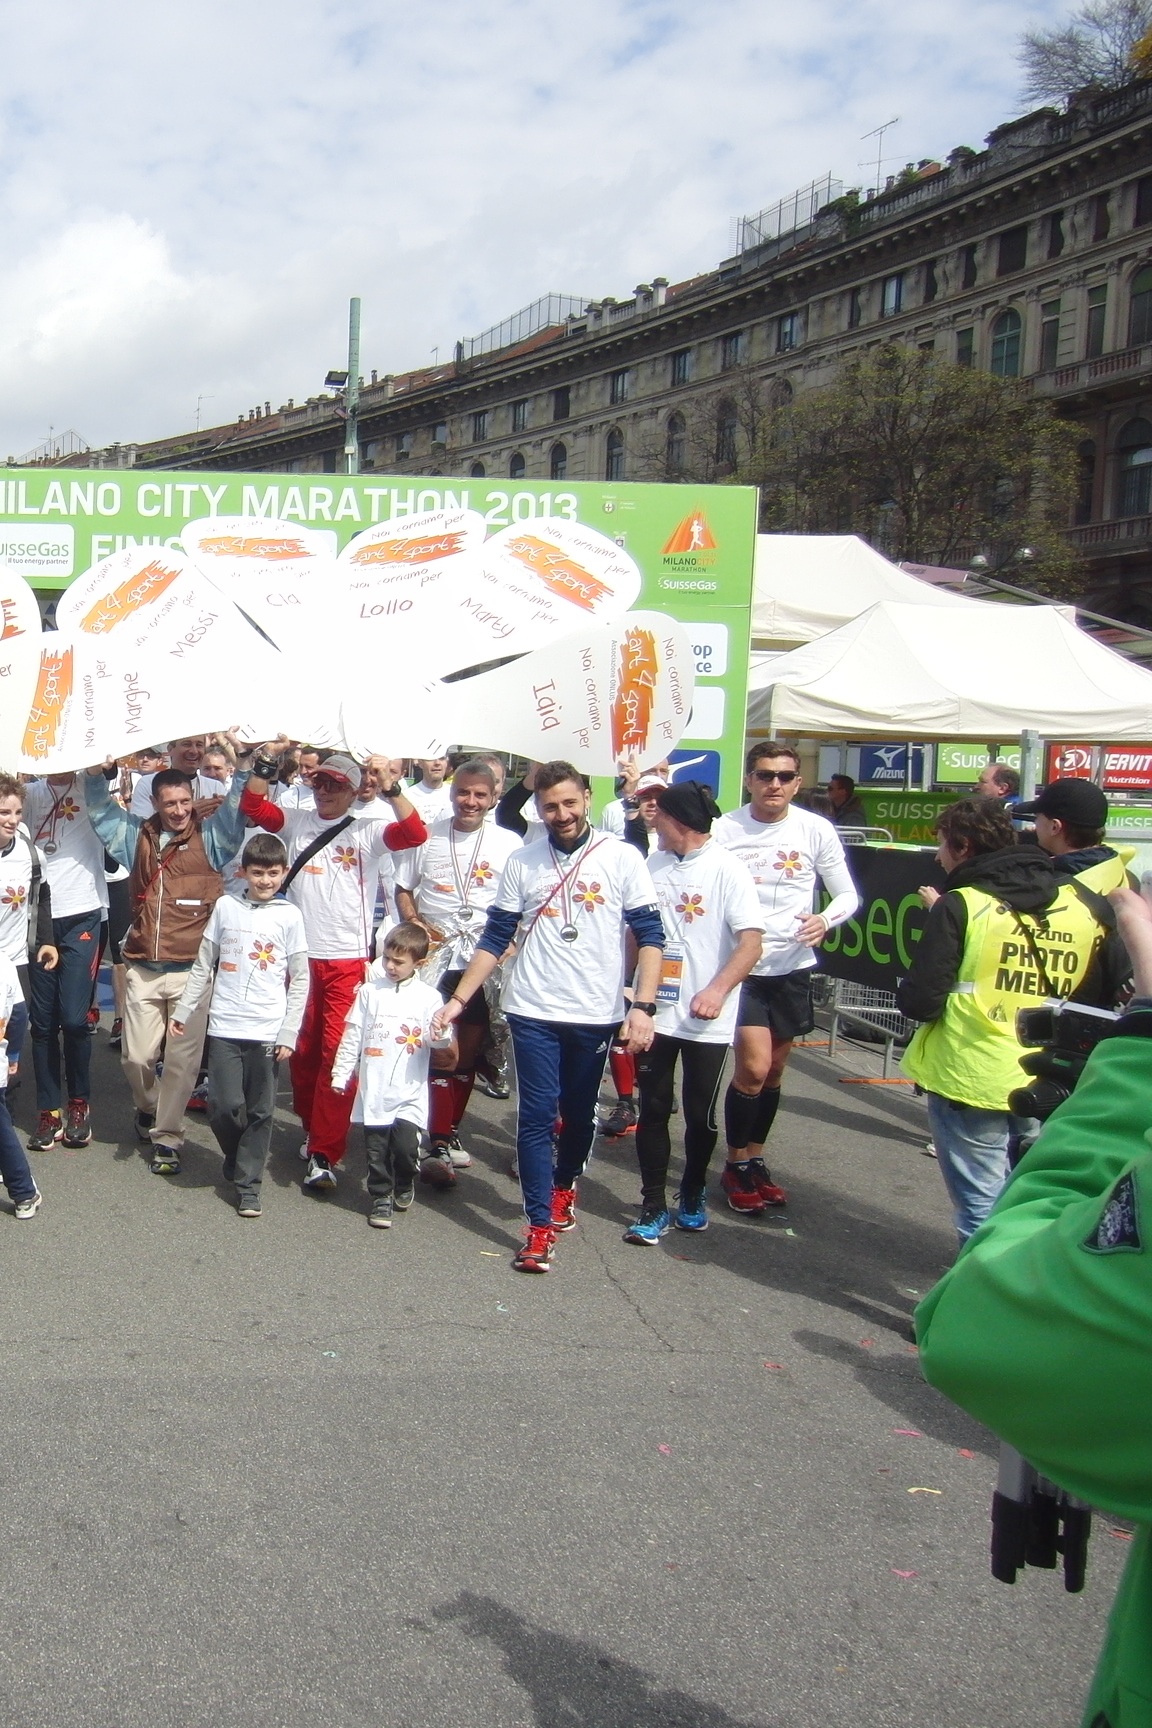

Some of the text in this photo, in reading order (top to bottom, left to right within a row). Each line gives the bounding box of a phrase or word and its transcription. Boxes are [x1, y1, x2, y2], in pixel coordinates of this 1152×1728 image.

[136, 482, 228, 519] CITY
[242, 484, 469, 523] MARATHON
[485, 491, 578, 527] 2013
[444, 514, 466, 529] per
[206, 538, 298, 556] art 4 sport
[358, 536, 450, 562] art 4 sport
[512, 540, 544, 562] art
[543, 552, 568, 566] 4
[420, 572, 443, 588] per
[545, 568, 596, 599] sport
[663, 579, 717, 590] SuisseGas
[90, 572, 164, 632] art 4 sport
[360, 598, 414, 618] Lollo
[460, 597, 516, 639] Marty
[169, 609, 219, 658] Messi
[610, 640, 618, 678] Associazione
[28, 662, 63, 752] art 4 sport
[82, 660, 112, 749] Noi corriamo per
[123, 672, 151, 734] Marghe
[532, 678, 563, 732] Iaia
[572, 646, 602, 750] Noi corriamo per
[621, 637, 654, 740] art 4 sport
[656, 636, 684, 741] Noi corriamo per
[1106, 776, 1150, 784] Nutrition
[671, 964, 679, 975] 3
